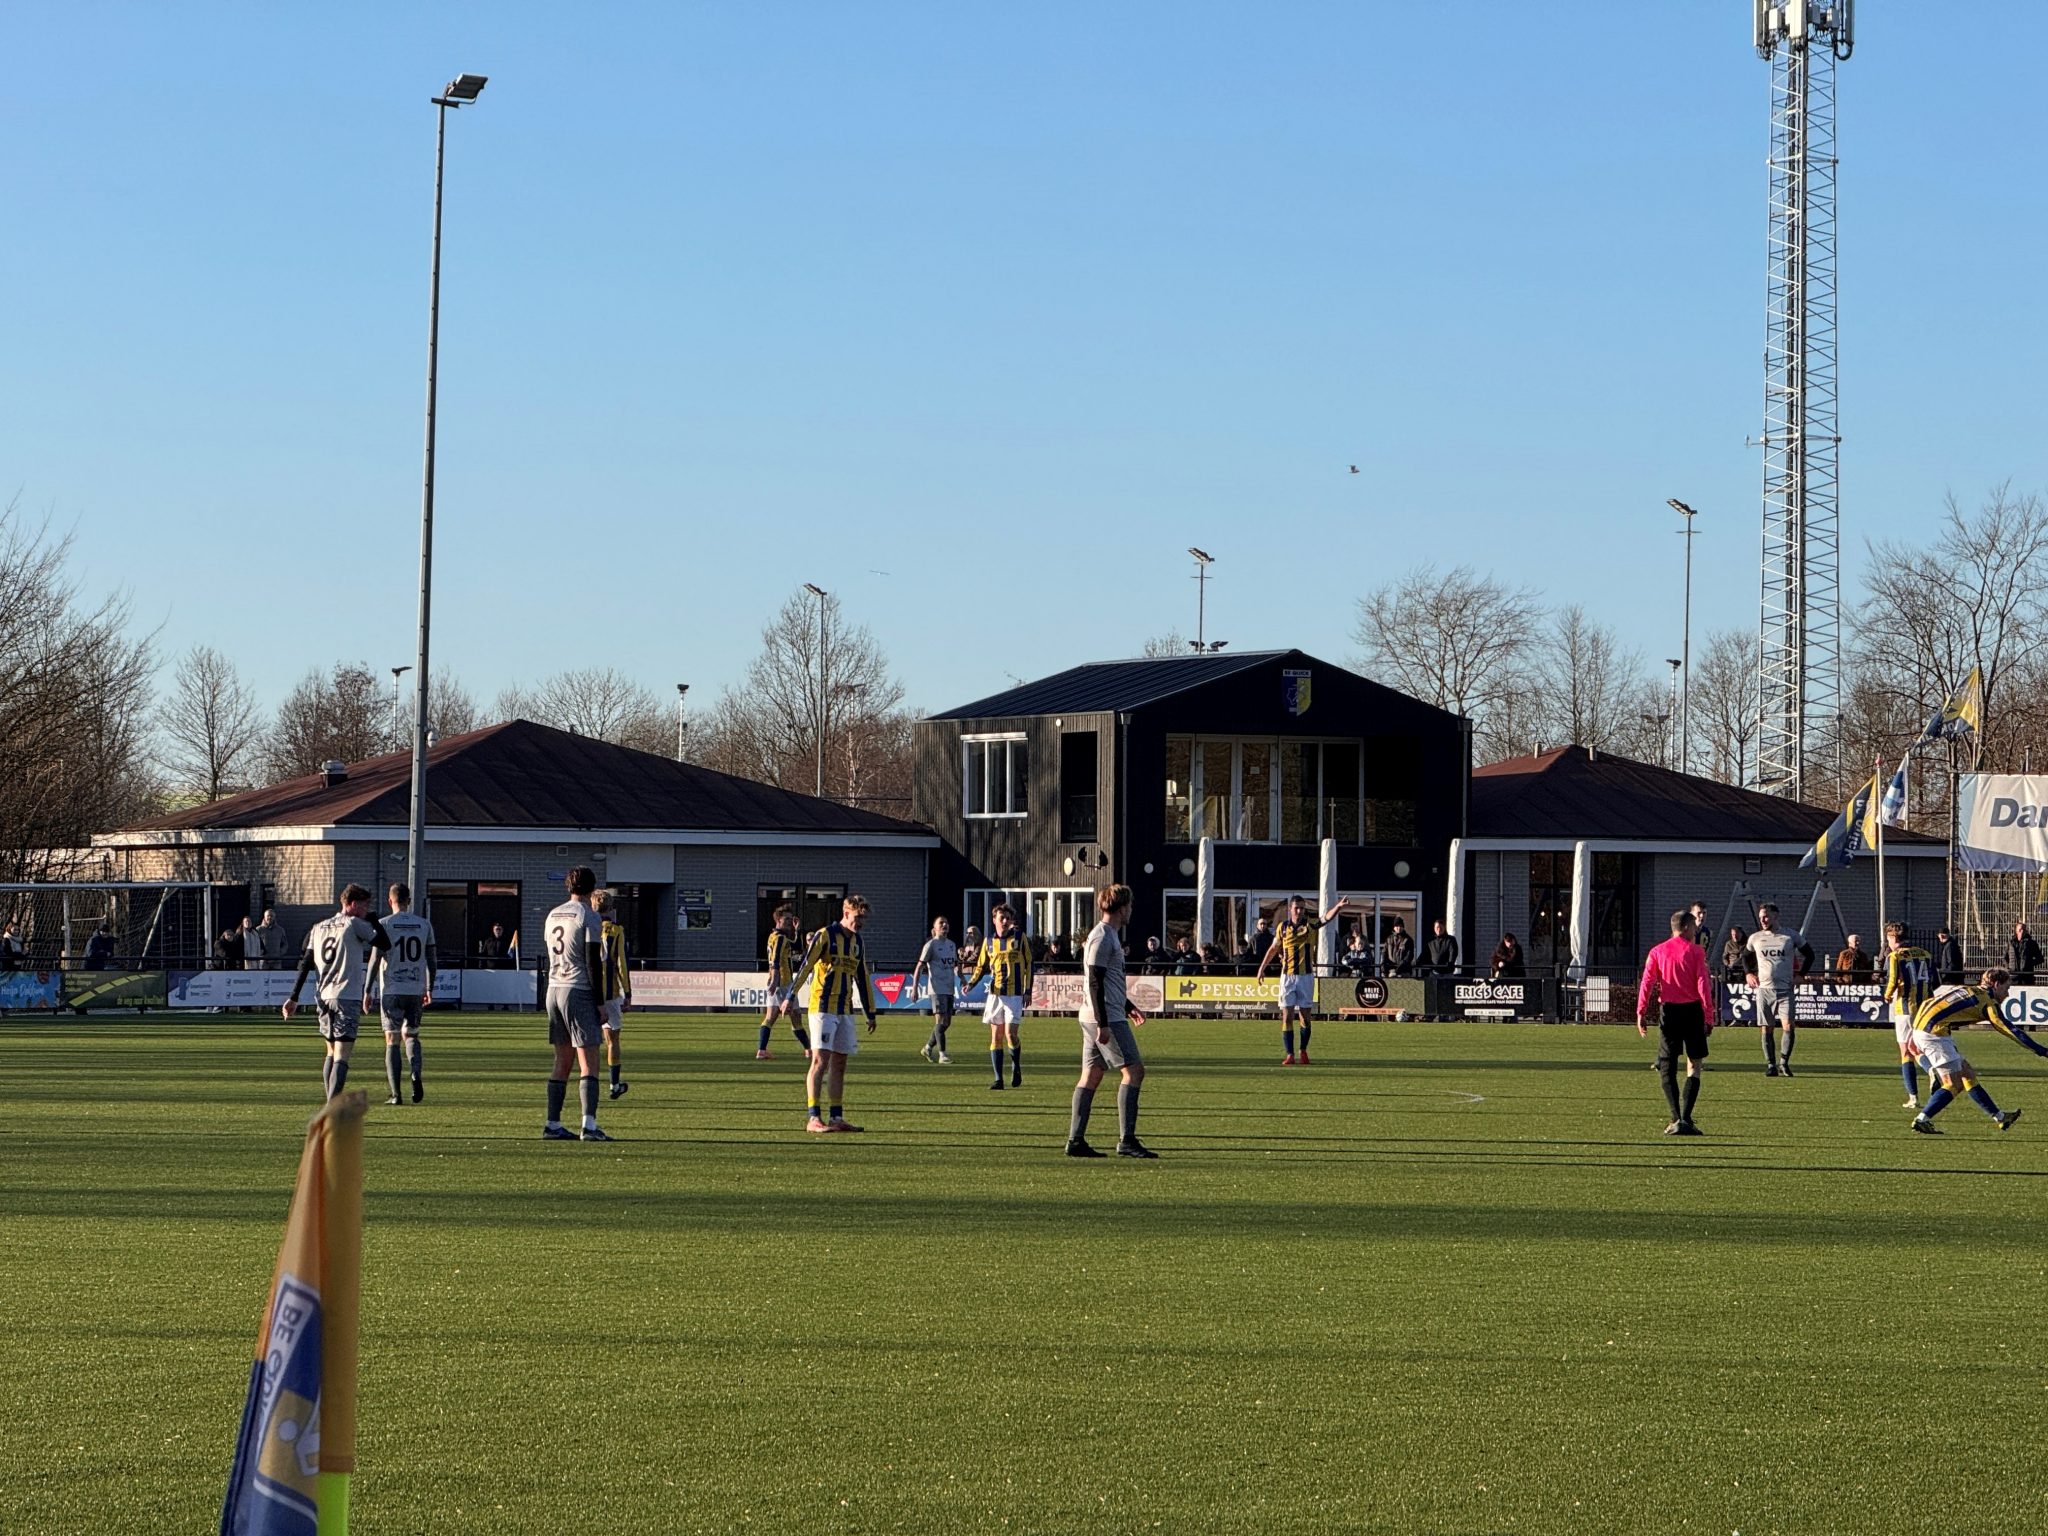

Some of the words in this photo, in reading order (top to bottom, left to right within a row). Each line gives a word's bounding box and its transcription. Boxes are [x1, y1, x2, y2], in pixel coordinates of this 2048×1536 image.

[321, 936, 337, 964] 6
[394, 936, 422, 963] 10
[551, 925, 565, 956] 3
[1761, 949, 1785, 957] VCN
[679, 976, 721, 986] DOKKUM
[1905, 961, 1930, 985] 14
[1455, 984, 1492, 999] ERIC'S
[1492, 985, 1524, 999] CAFE
[1834, 985, 1881, 997] VISSER
